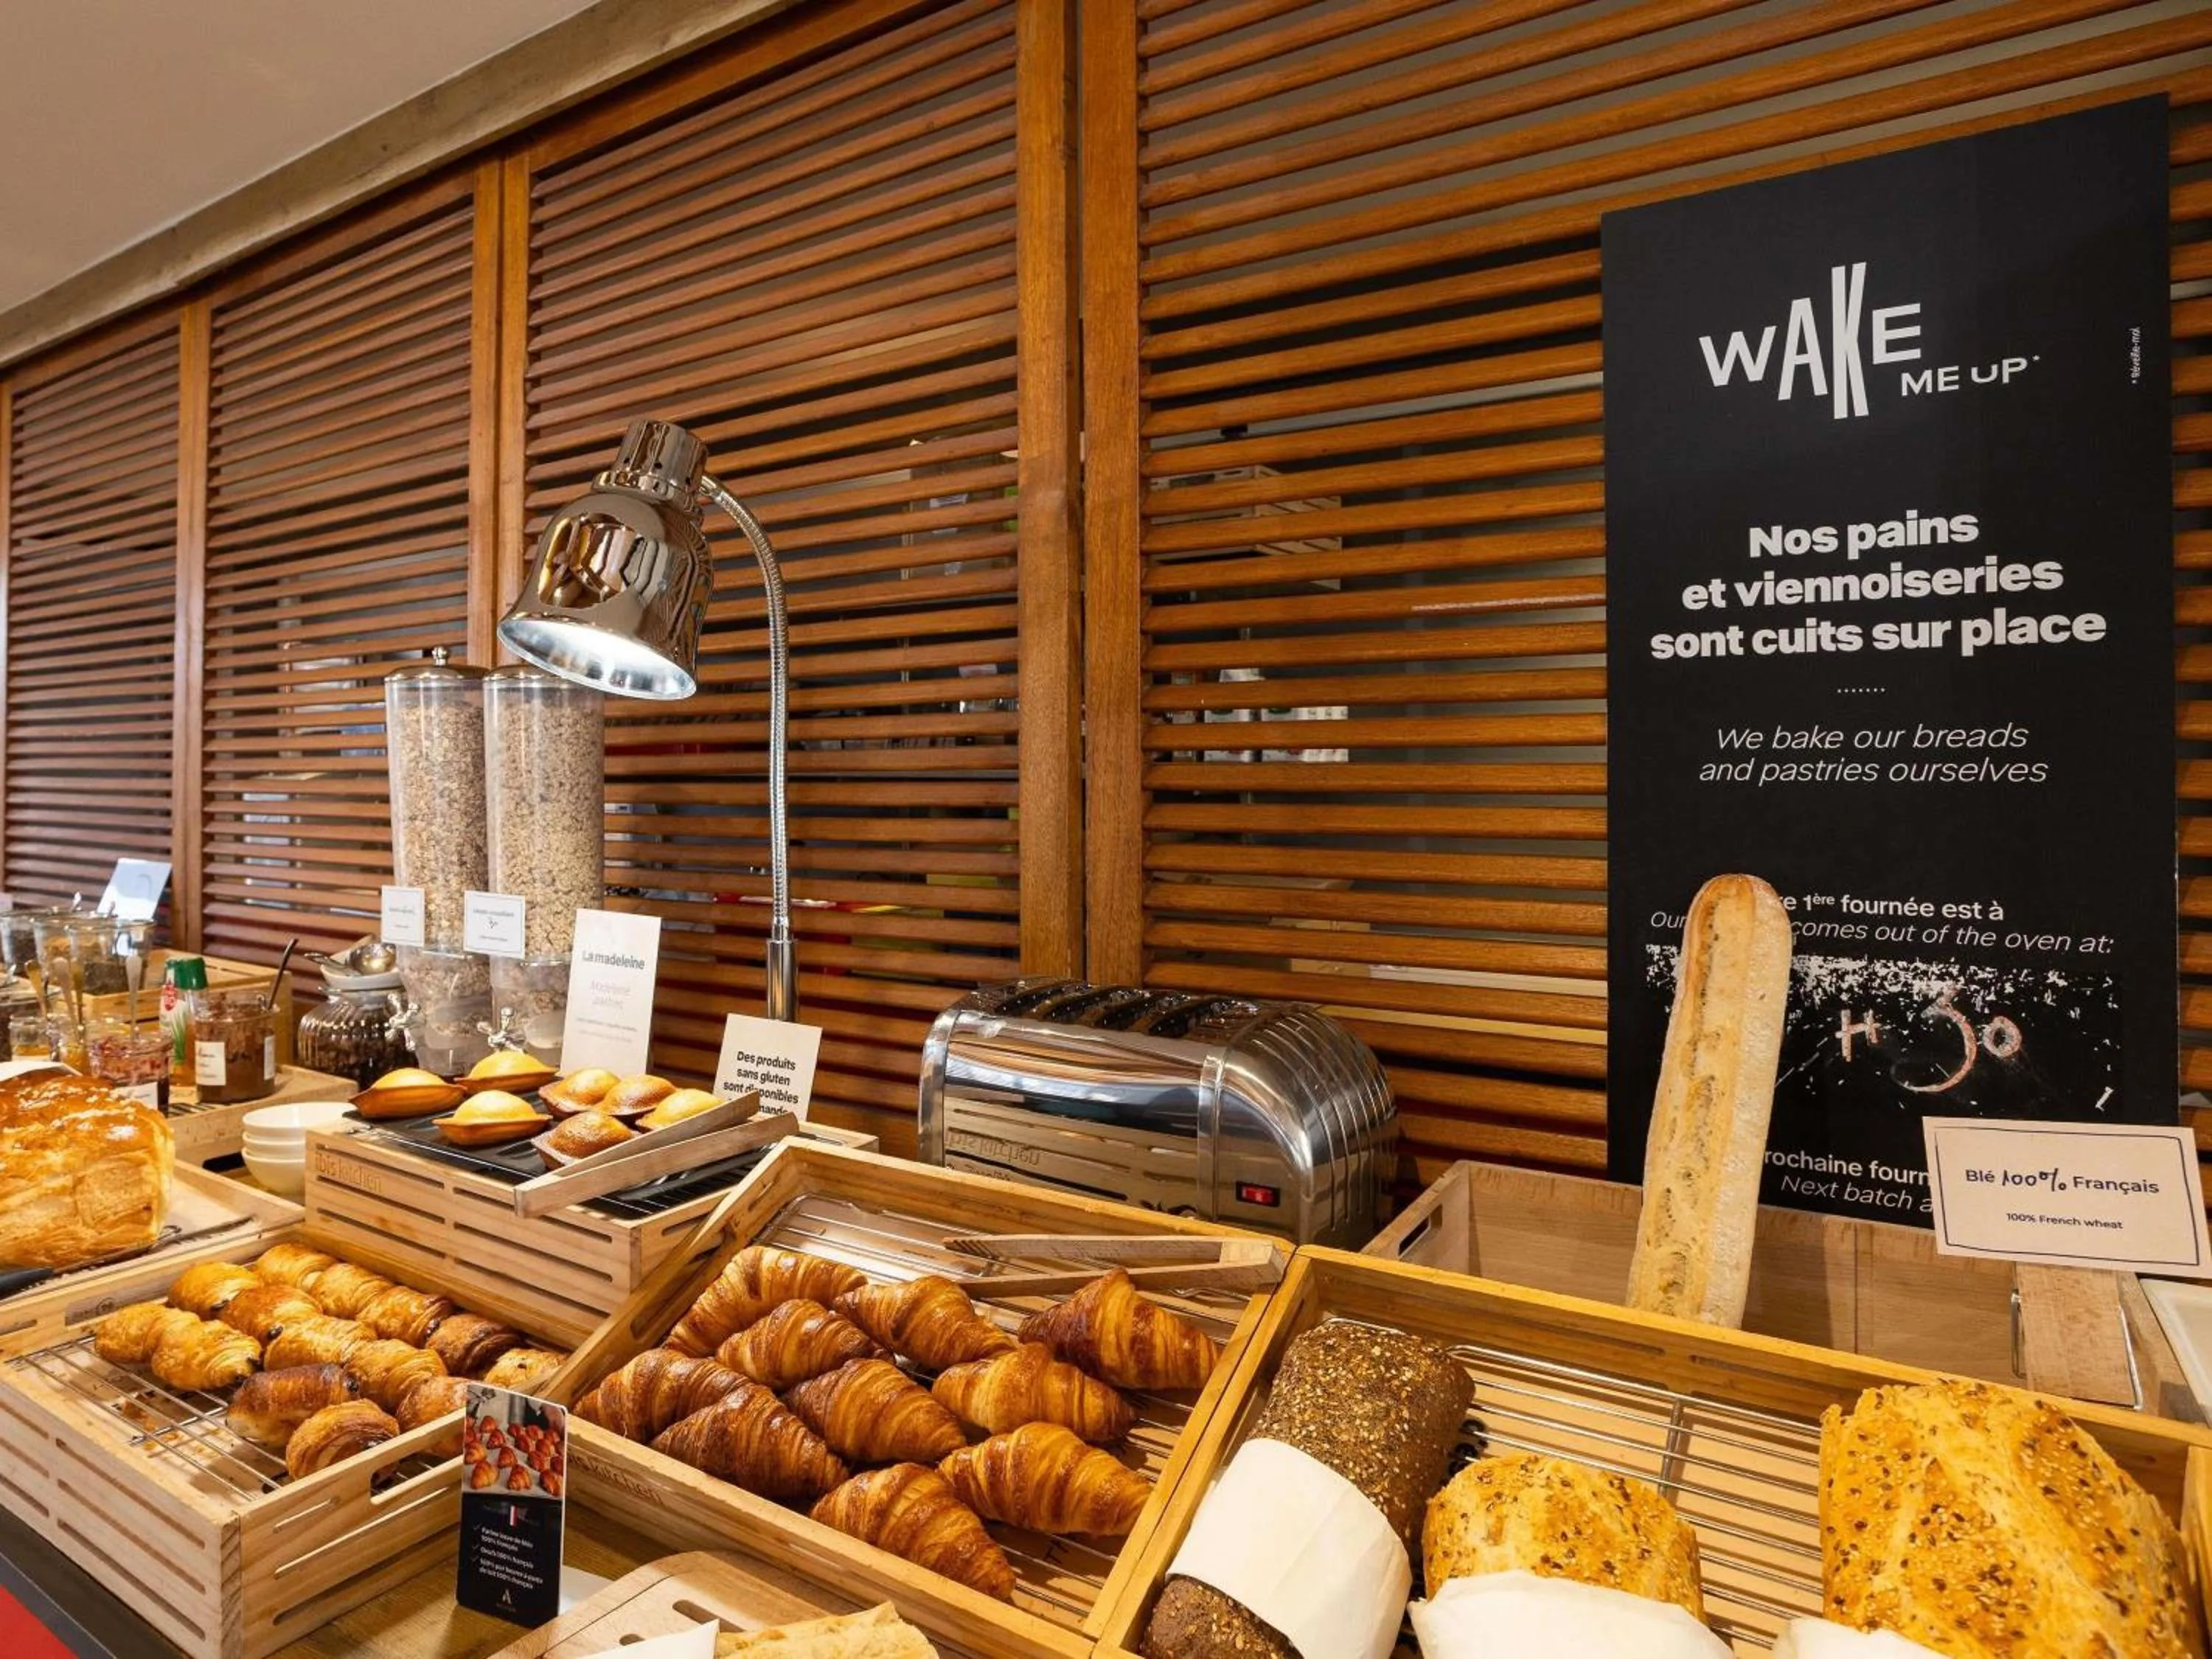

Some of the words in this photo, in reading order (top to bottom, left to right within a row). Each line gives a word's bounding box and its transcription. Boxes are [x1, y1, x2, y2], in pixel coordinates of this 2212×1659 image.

[1699, 262, 1921, 419] WAKE
[1901, 366, 1959, 396] ME
[1749, 525, 1839, 558] Nos
[1847, 509, 1979, 560] pains
[1682, 578, 1726, 610] et
[1734, 555, 2064, 607] viennoiseries
[1650, 625, 1744, 659] sont
[1752, 617, 1863, 655] cuits
[1872, 620, 1952, 650] sur
[1961, 607, 2107, 657] place
[1718, 728, 1764, 749] We
[1773, 725, 1844, 749] bake
[1854, 729, 1906, 748] our
[1913, 722, 2029, 748] breads
[1700, 757, 1755, 781] and
[1759, 757, 1880, 787] pastries
[1888, 757, 2049, 782] ourselves
[1803, 893, 1835, 911] 1ère
[1840, 894, 1935, 917] fournée
[1941, 902, 1982, 919] est
[1989, 900, 2004, 920] à
[1792, 920, 1868, 939] comes
[1875, 925, 1916, 942] out
[1922, 925, 1951, 944] of
[1955, 926, 1997, 947] the
[2005, 933, 2071, 950] oven
[2079, 935, 2114, 953] at:
[594, 953, 645, 970] madeleine
[737, 1051, 756, 1063] Des
[757, 1056, 796, 1071] produits
[737, 1068, 758, 1080] sans
[760, 1071, 790, 1085] gluten
[723, 1082, 744, 1093] sont
[745, 1084, 799, 1104] diponibles
[1764, 1150, 1863, 1176] rochaine
[1869, 1161, 1930, 1186] fourn
[1965, 1169, 1994, 1183] Blé
[2002, 1168, 2067, 1192] 100%
[2073, 1176, 2160, 1195] Français
[1781, 1175, 1839, 1199] Next
[1844, 1182, 1912, 1209] batch
[1919, 1197, 1933, 1212] a
[2006, 1213, 2036, 1222] 100%
[2039, 1215, 2081, 1226] French
[2084, 1219, 2124, 1229] wheat
